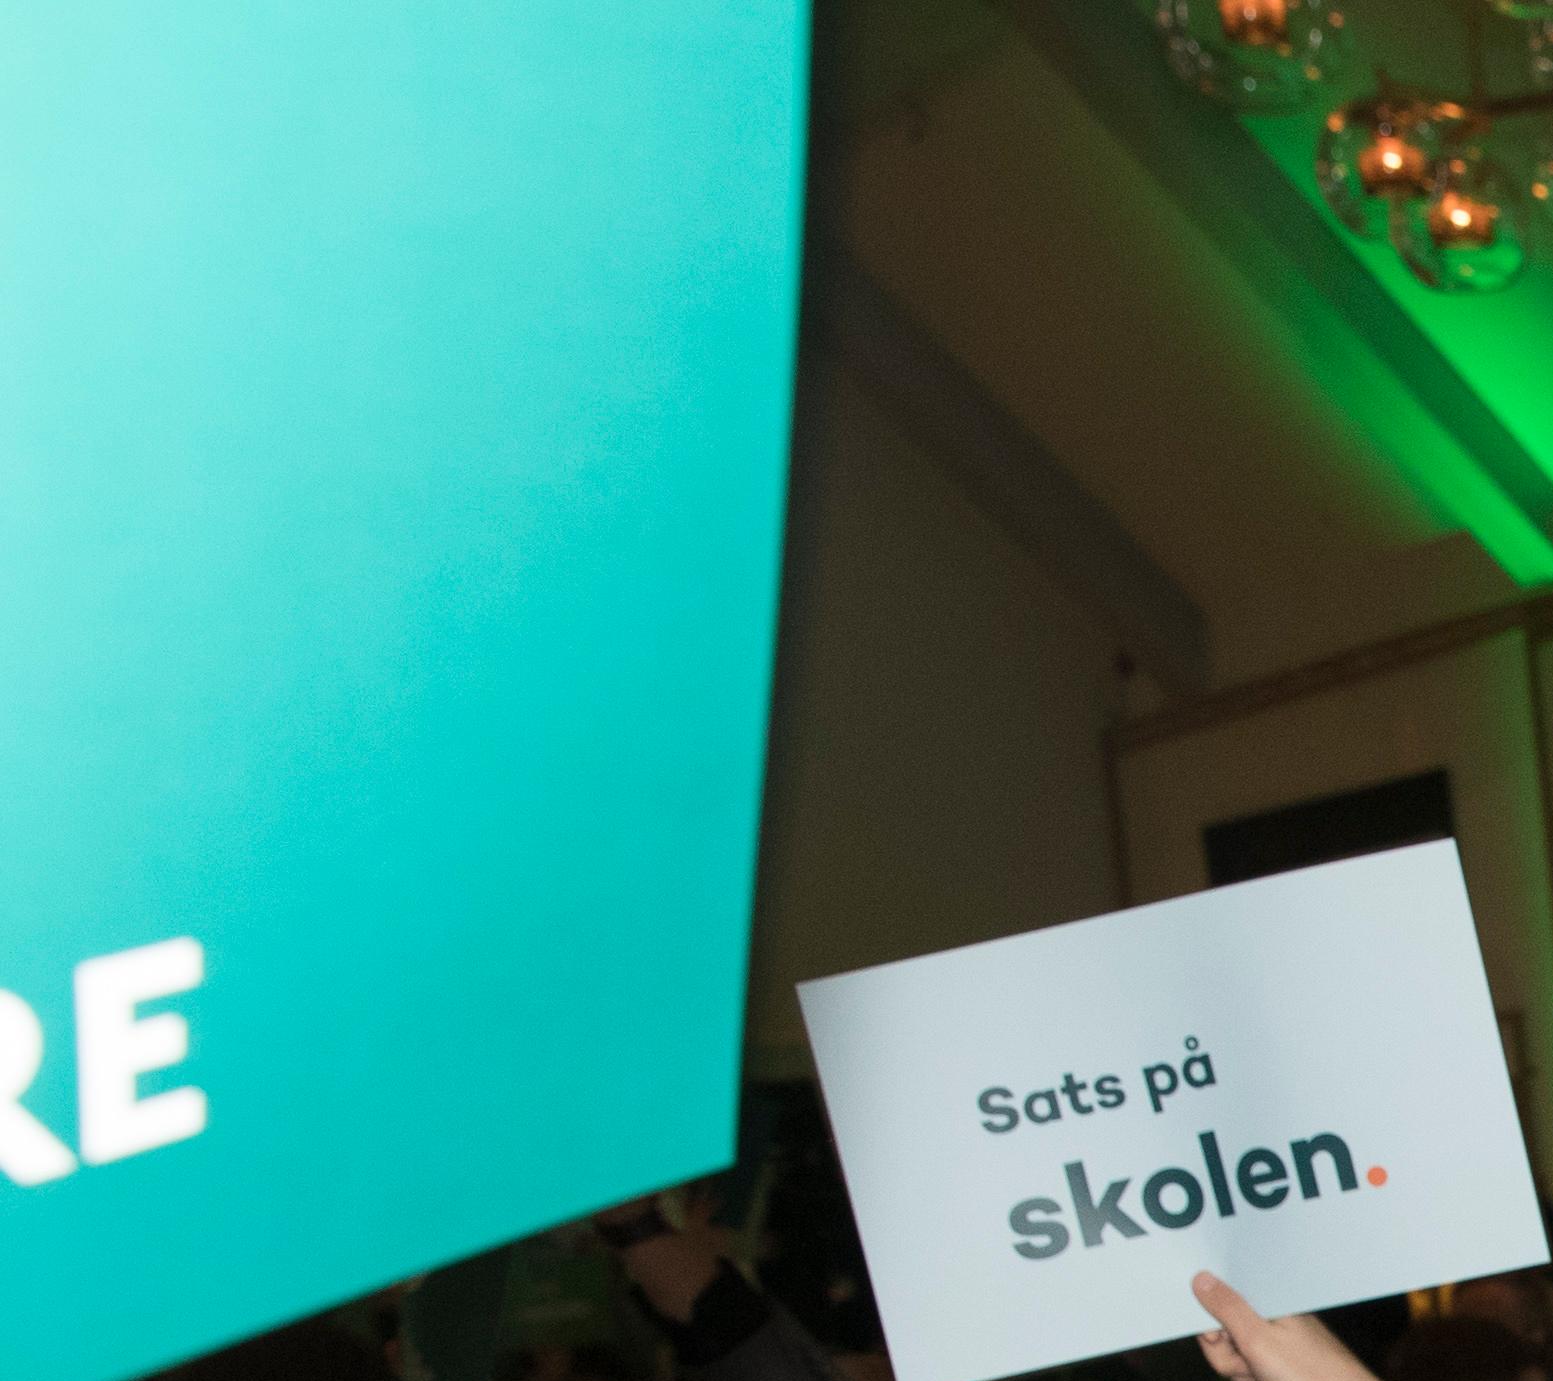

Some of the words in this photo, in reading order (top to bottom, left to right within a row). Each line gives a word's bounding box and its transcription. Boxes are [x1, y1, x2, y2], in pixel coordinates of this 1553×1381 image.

[977, 1072, 1127, 1135] Sats
[1142, 1036, 1217, 1113] på
[1008, 1129, 1388, 1260] skolen.
